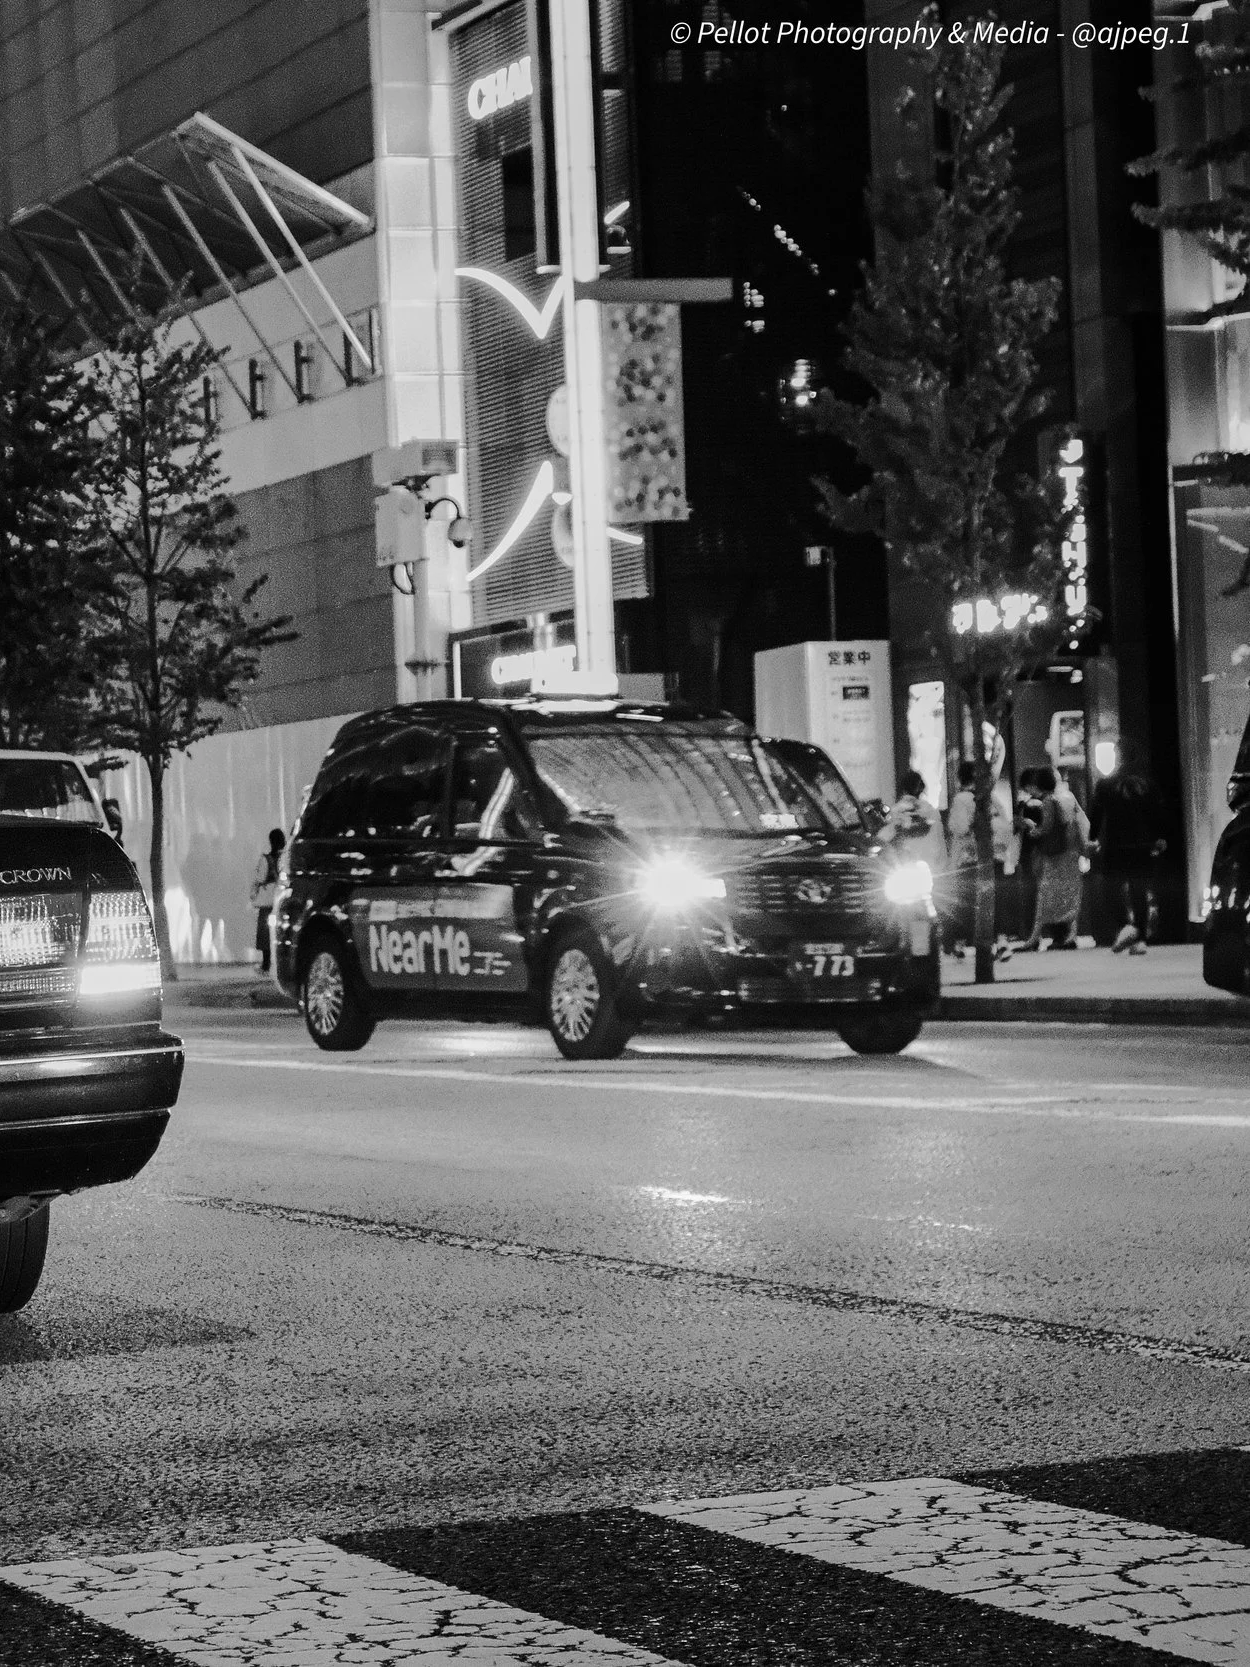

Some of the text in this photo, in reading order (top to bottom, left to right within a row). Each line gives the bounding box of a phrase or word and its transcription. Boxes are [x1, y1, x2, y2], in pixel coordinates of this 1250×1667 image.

[827, 650, 871, 666] 営業中
[368, 924, 471, 976] NearMe
